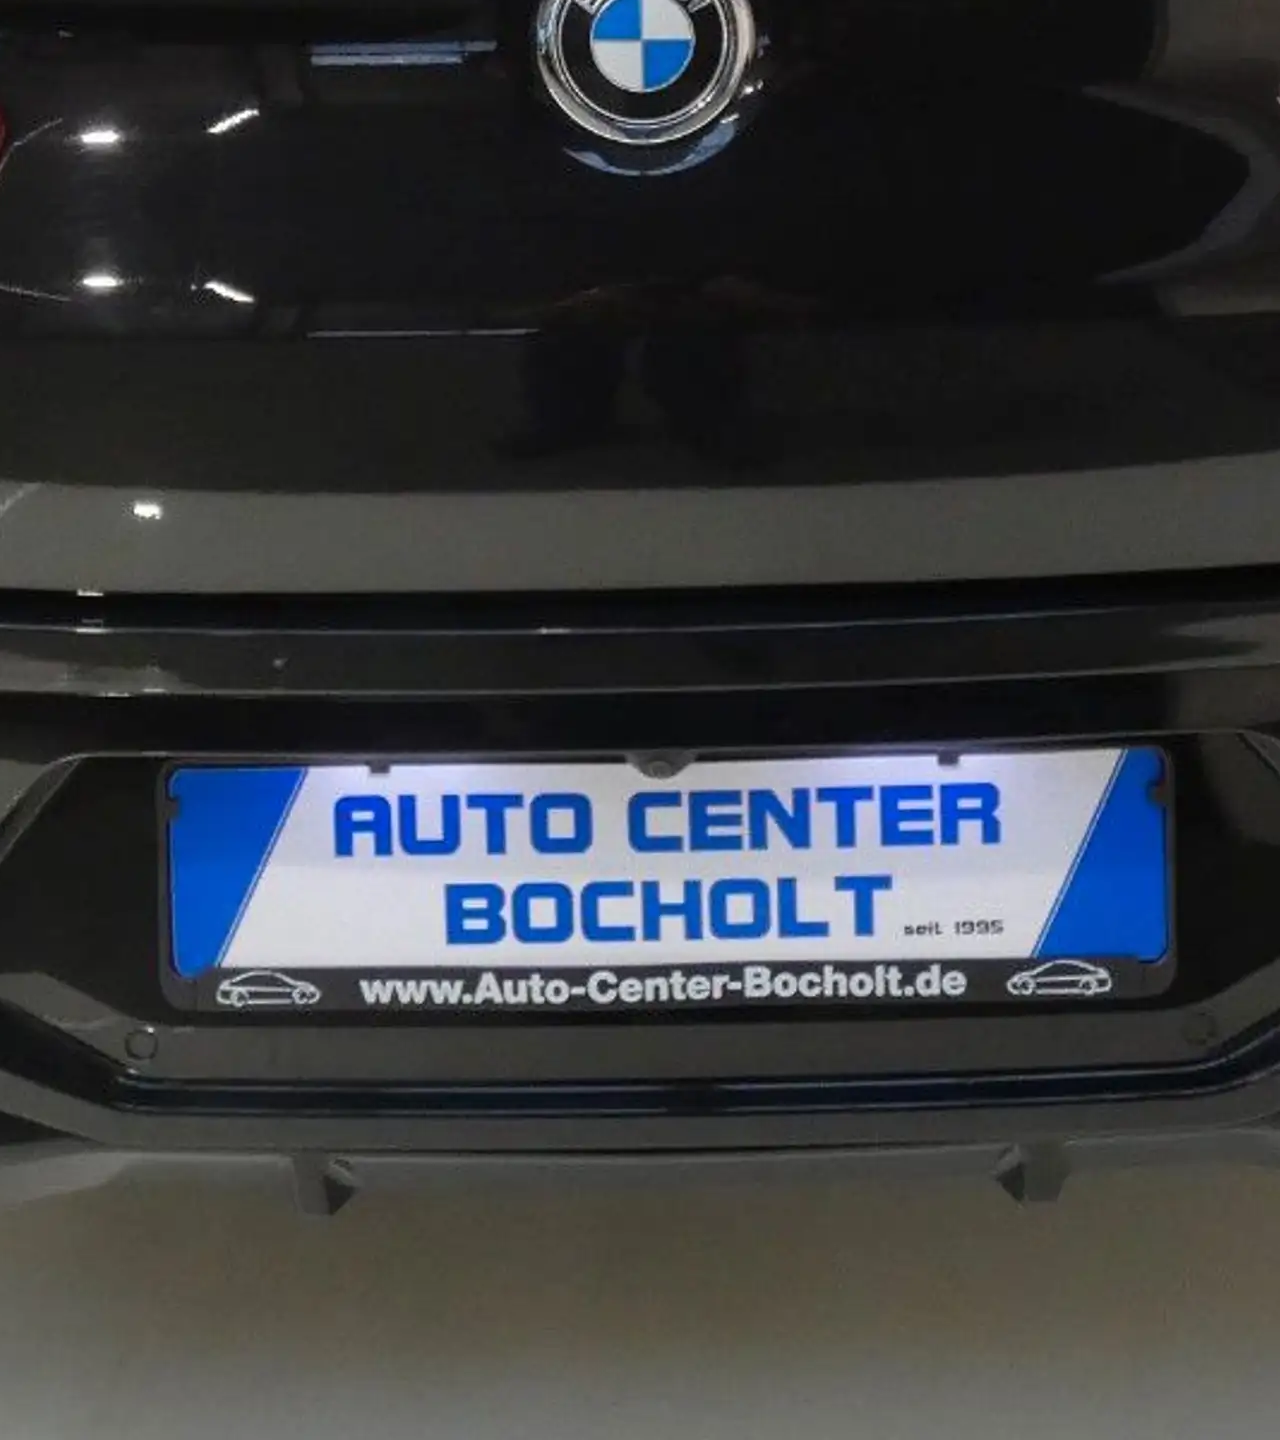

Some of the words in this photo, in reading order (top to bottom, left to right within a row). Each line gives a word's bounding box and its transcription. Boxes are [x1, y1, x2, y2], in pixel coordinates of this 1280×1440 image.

[333, 793, 593, 857] AUTO
[626, 781, 1003, 854] CENTER
[443, 874, 895, 946] BOCHOLT
[954, 918, 1005, 936] 1995
[359, 964, 968, 1006] www.Auto-Center-Bocholt.de
